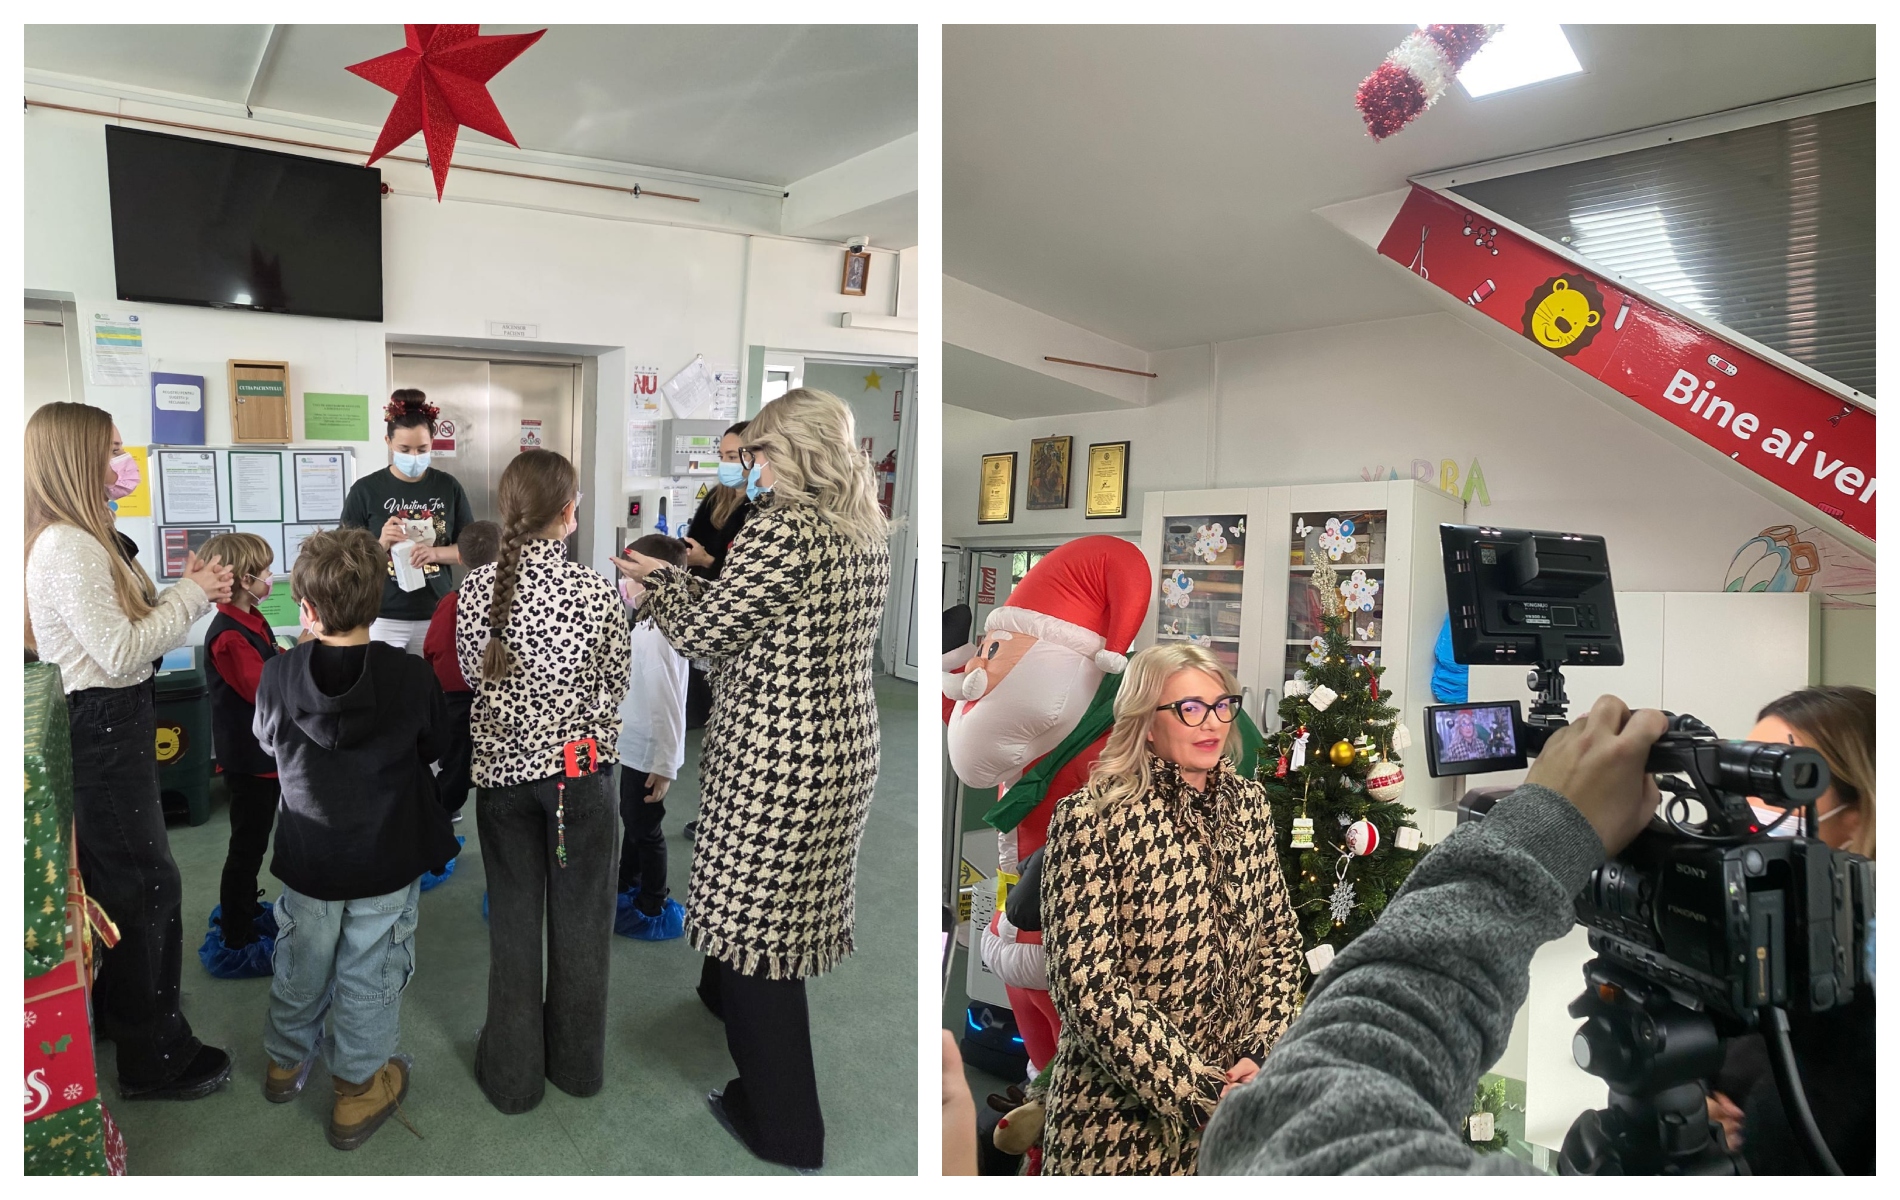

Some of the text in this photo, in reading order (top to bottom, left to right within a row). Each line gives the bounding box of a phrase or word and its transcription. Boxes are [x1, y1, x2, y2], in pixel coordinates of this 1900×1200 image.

[633, 374, 658, 394] NU
[1662, 368, 1760, 440] Bine
[1761, 427, 1815, 466] ai
[383, 497, 445, 514] Waiting For
[632, 504, 639, 514] 2
[1675, 862, 1708, 879] SONY
